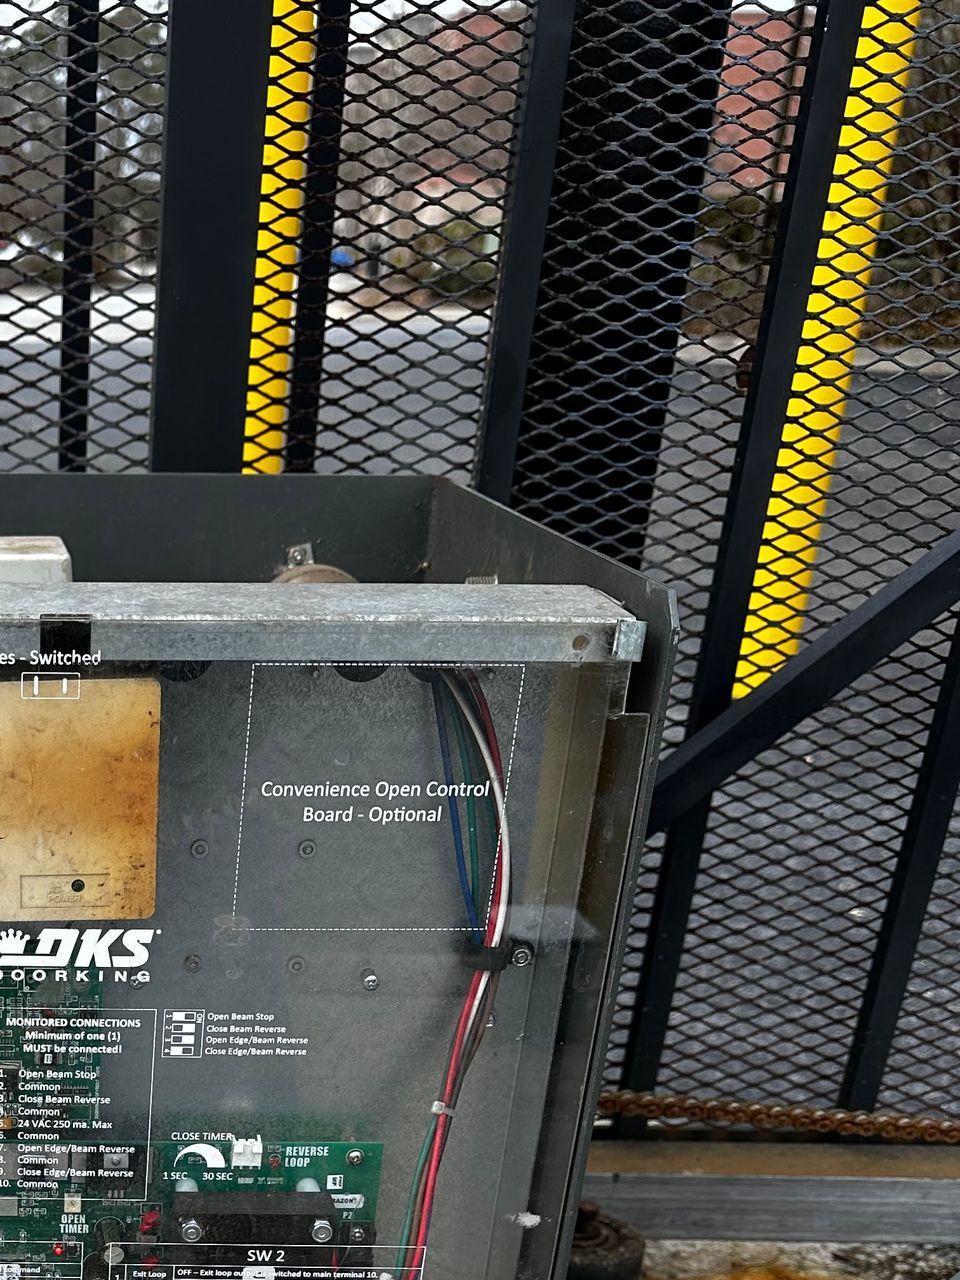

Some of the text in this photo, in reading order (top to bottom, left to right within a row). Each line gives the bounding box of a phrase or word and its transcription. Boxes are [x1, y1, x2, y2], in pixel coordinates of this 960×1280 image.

[30, 649, 101, 665] Switched
[260, 780, 490, 800] Convenience Open Control
[303, 806, 353, 822] Board
[368, 806, 442, 825] Optional
[6, 1018, 140, 1027] MONITORED CONNECTIONS
[207, 1013, 274, 1023] Open Beam Stop
[25, 1031, 72, 1040] Minimum
[75, 1031, 84, 1040] of
[108, 1032, 120, 1042] (1)
[206, 1037, 227, 1046] Open
[230, 1036, 274, 1045] Edge/Beam
[23, 1045, 122, 1054] MUST be connected!
[228, 1048, 272, 1057] Edge/Beam
[275, 1048, 307, 1056] Reverse
[0, 1070, 97, 1080] 1. Open Beam Stop
[19, 1083, 60, 1091] Common
[18, 1095, 43, 1103] Close
[45, 1096, 72, 1104] Beam
[74, 1096, 110, 1104] Reverse
[18, 1120, 29, 1128] 24
[31, 1120, 51, 1128] VAC
[92, 1121, 112, 1129] Max
[171, 1132, 233, 1141] CLOSE TIMER
[0, 1144, 135, 1155] 7. Open Edge/Beam Reverse
[286, 1147, 329, 1156] REVERSE
[285, 1158, 310, 1167] LOOP
[170, 1172, 188, 1180] SEC
[216, 1173, 233, 1181] SEC
[61, 1215, 85, 1223] OPEN
[59, 1224, 89, 1233] TIMER
[247, 1250, 285, 1261] SW 2
